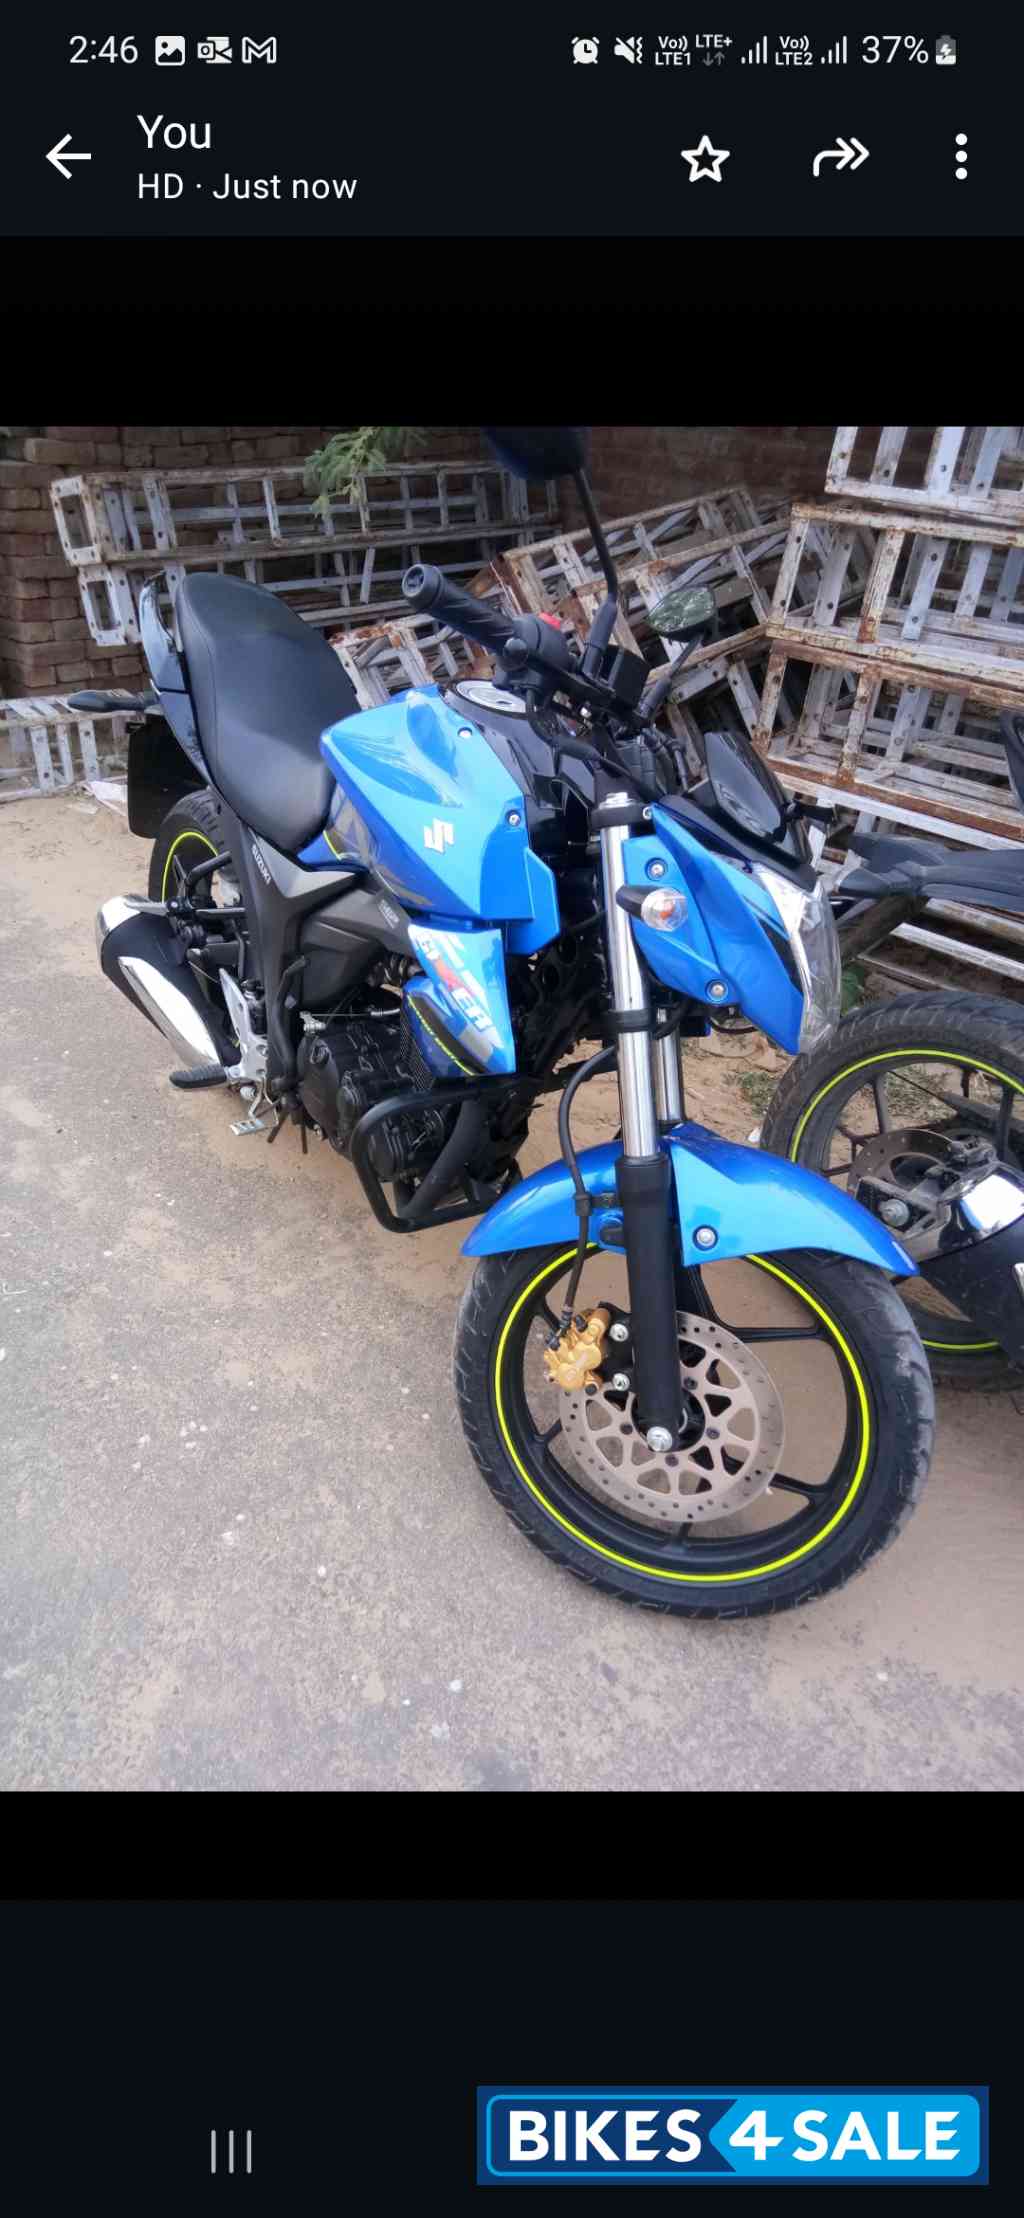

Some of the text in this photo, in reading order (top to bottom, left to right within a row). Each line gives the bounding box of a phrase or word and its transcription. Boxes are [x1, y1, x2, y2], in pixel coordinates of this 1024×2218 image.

[69, 35, 139, 64] 2:46
[695, 34, 733, 48] LTE+
[862, 35, 929, 64] 37%
[655, 51, 691, 66] LTE1
[775, 51, 813, 66] LTE2
[137, 114, 211, 150] You
[138, 173, 358, 200] HD Just now
